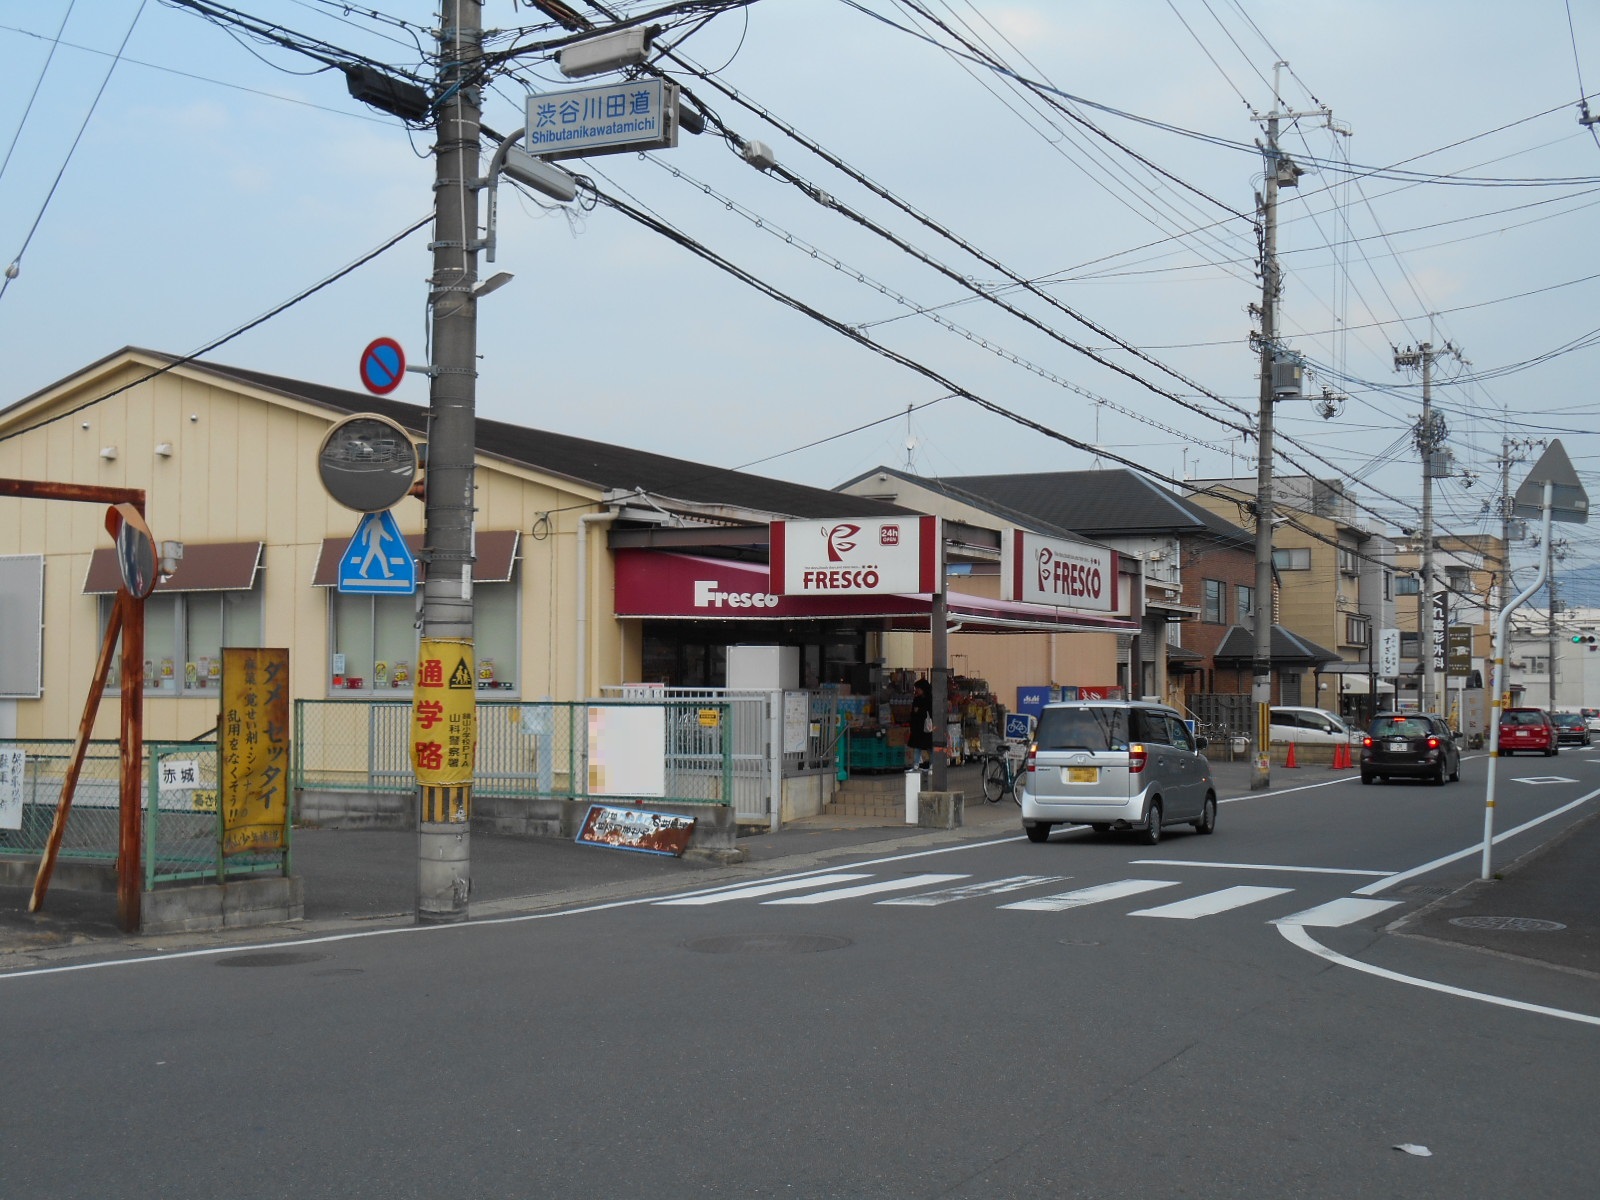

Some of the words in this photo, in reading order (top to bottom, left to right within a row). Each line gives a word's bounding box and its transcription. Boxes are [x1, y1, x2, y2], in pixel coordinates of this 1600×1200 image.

[537, 90, 650, 128] 渋谷川田道
[532, 117, 655, 144] Shibutanikawatamichi
[881, 529, 898, 537] 24h
[694, 580, 779, 608] Fresco
[803, 570, 880, 590] FRESCO
[1053, 560, 1101, 600] FRESCO
[415, 659, 444, 770] 通学路
[448, 713, 460, 768] 山科警察署
[163, 768, 194, 784] 赤城
